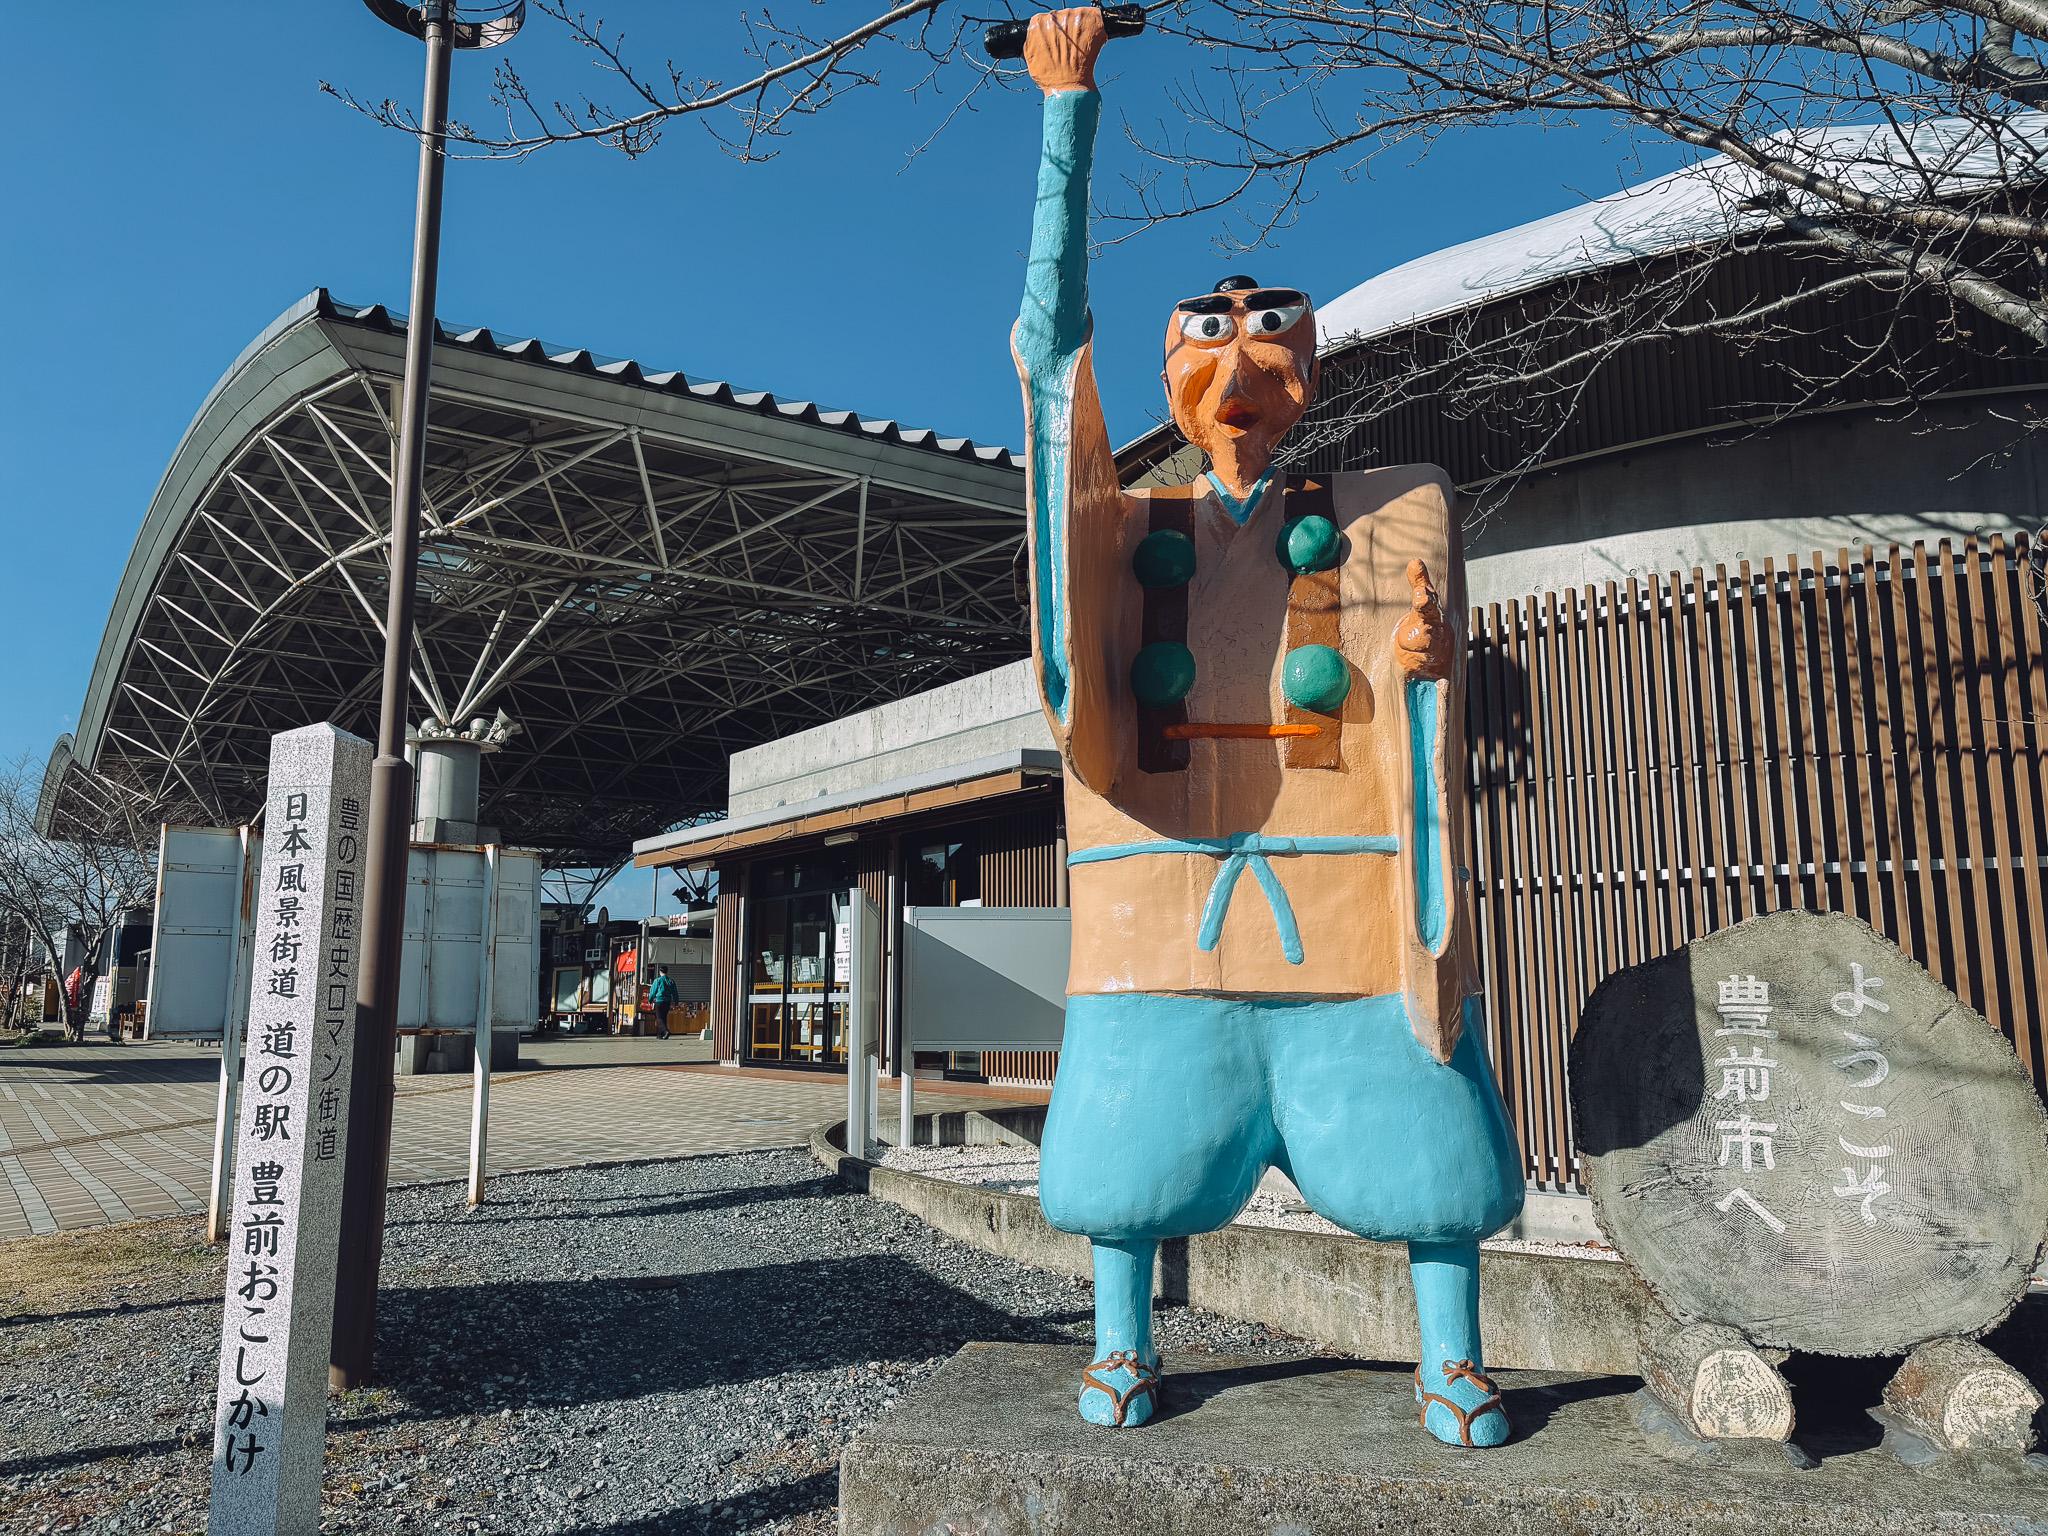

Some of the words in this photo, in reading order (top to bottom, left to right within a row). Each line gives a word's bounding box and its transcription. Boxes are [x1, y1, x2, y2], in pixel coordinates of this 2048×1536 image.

[267, 792, 312, 999] 日本風景街道
[314, 797, 360, 1163] 豊の国歴史ロマン街道
[250, 1021, 298, 1142] 道の駅
[1714, 974, 1786, 1233] 豊前市へ
[1831, 961, 1894, 1227] ようこそ
[225, 1160, 285, 1477] 豊前おこしかけ
